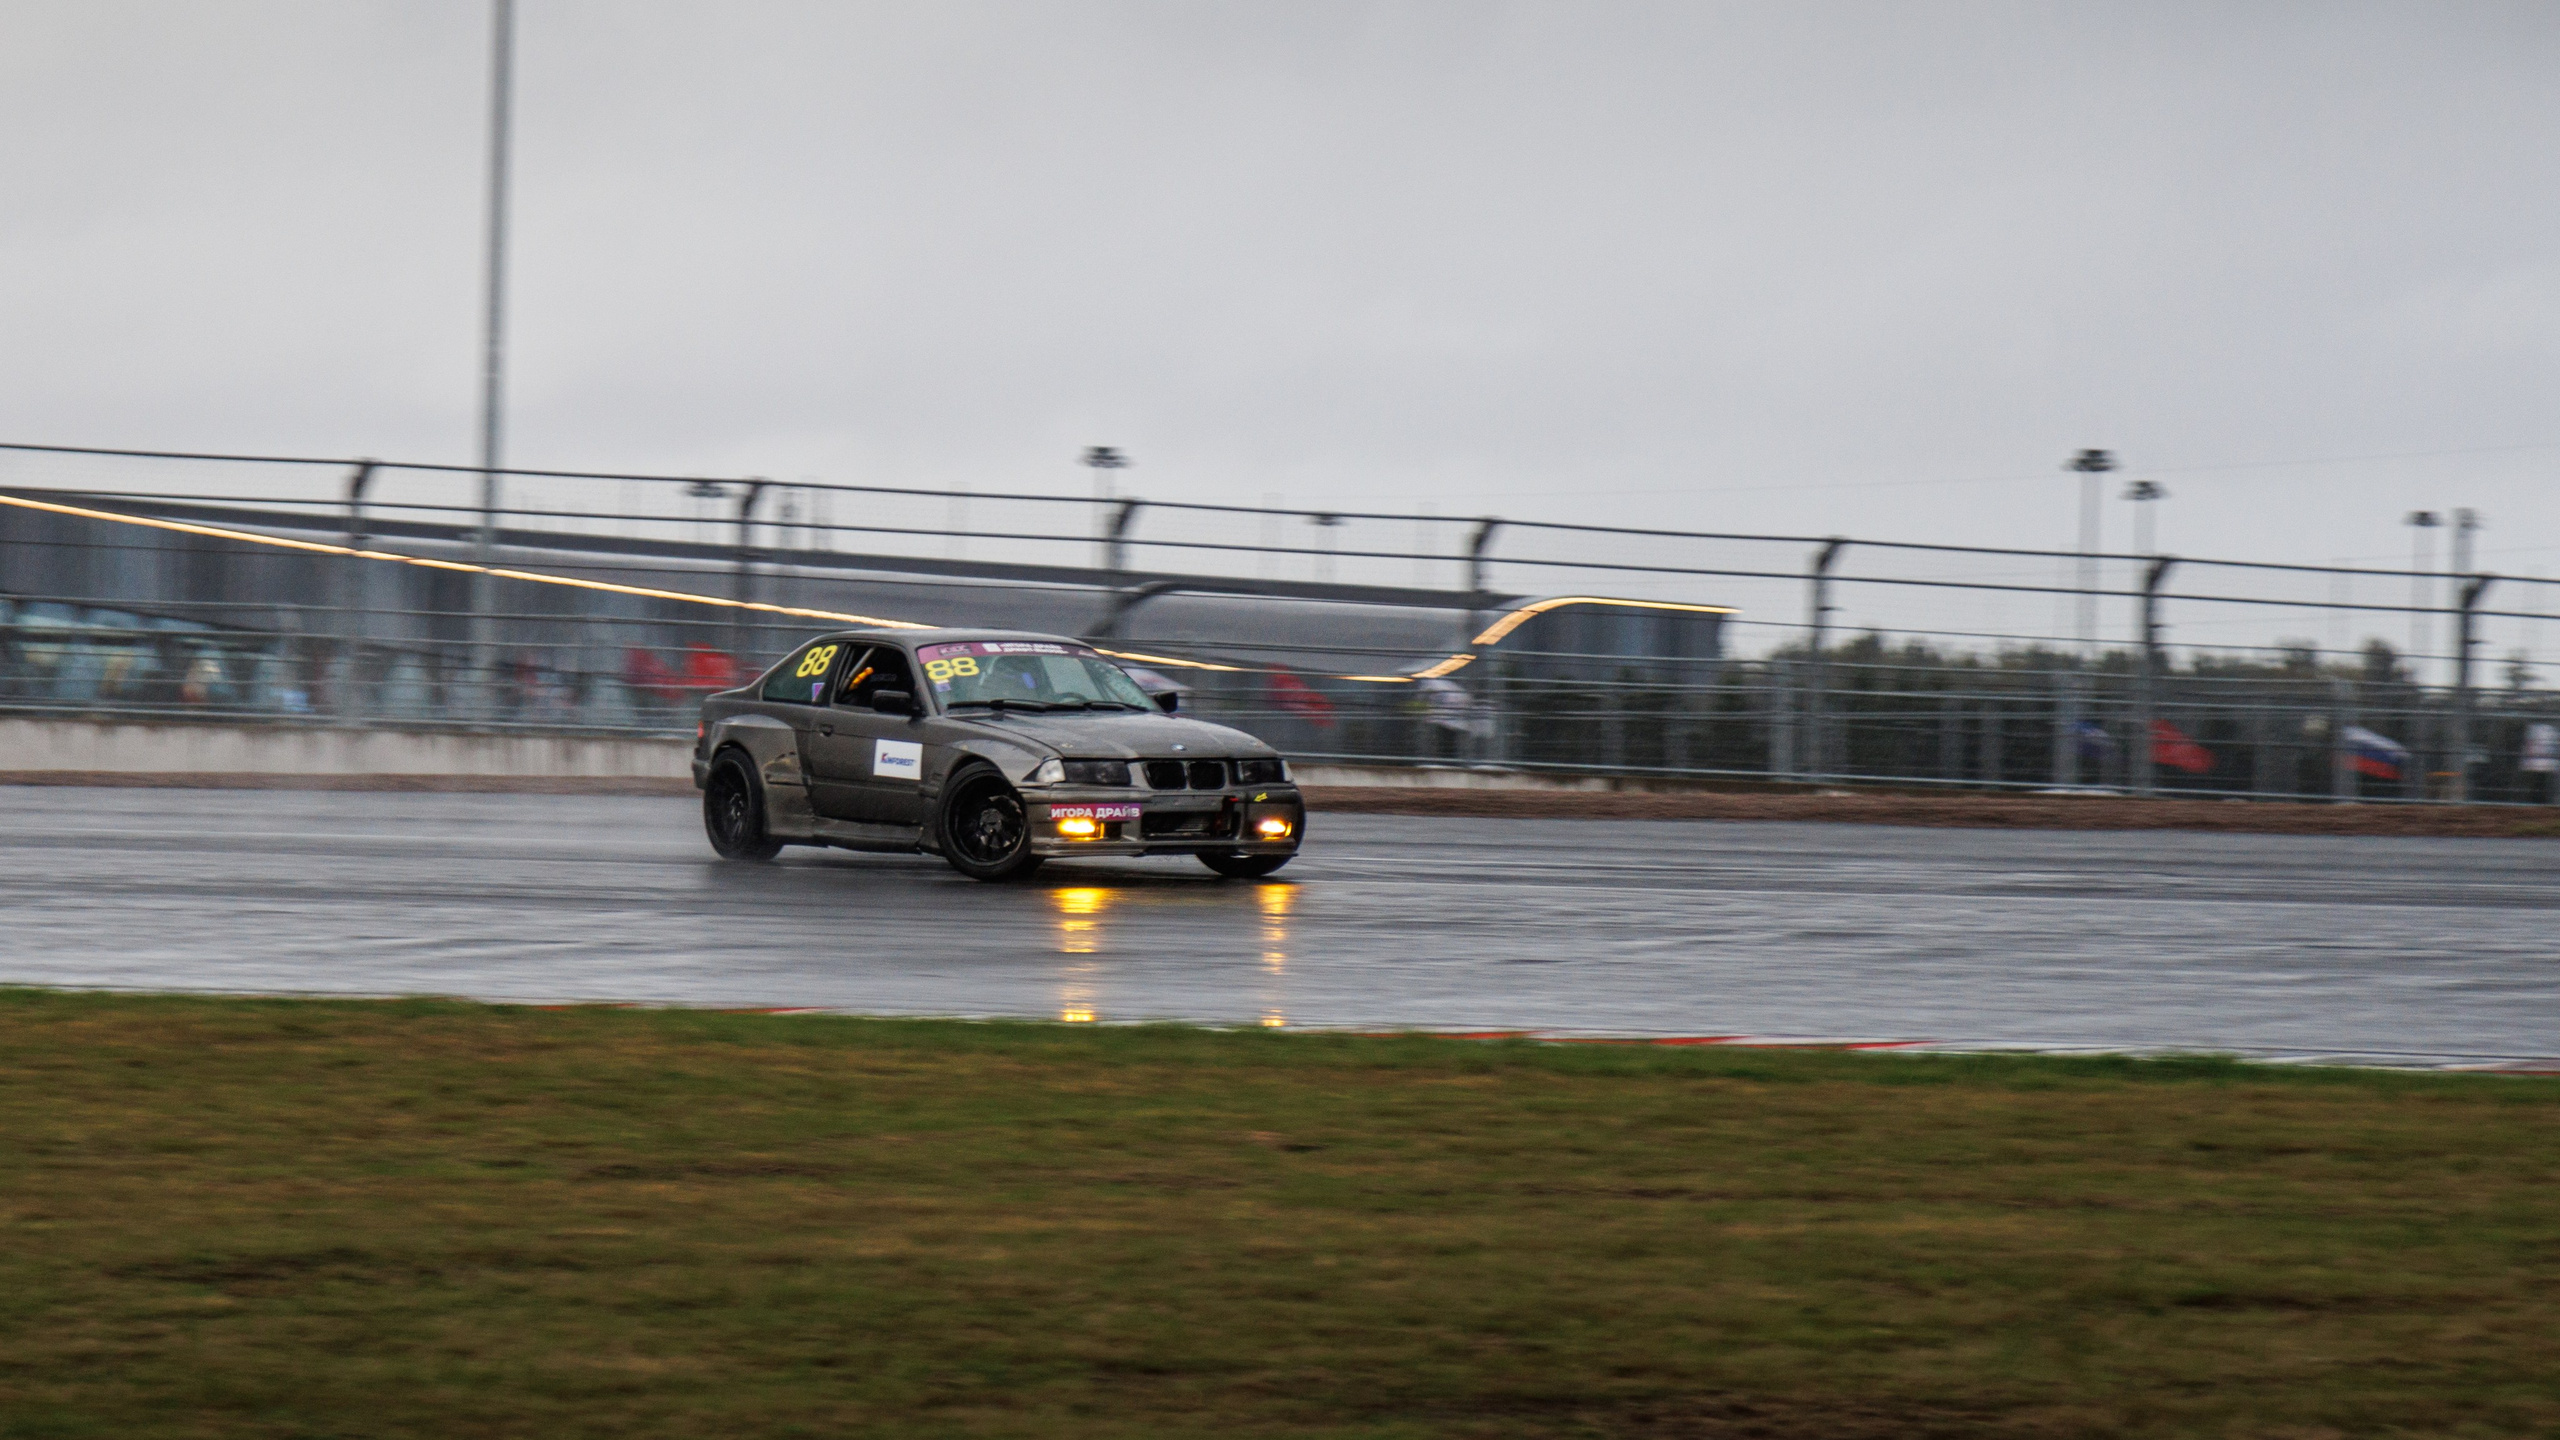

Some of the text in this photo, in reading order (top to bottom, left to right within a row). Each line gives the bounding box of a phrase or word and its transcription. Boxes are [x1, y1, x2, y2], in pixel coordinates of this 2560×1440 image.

[796, 644, 838, 677] 88
[925, 657, 981, 681] 88
[1051, 806, 1140, 818] ИГОРА ДРАЙВ
